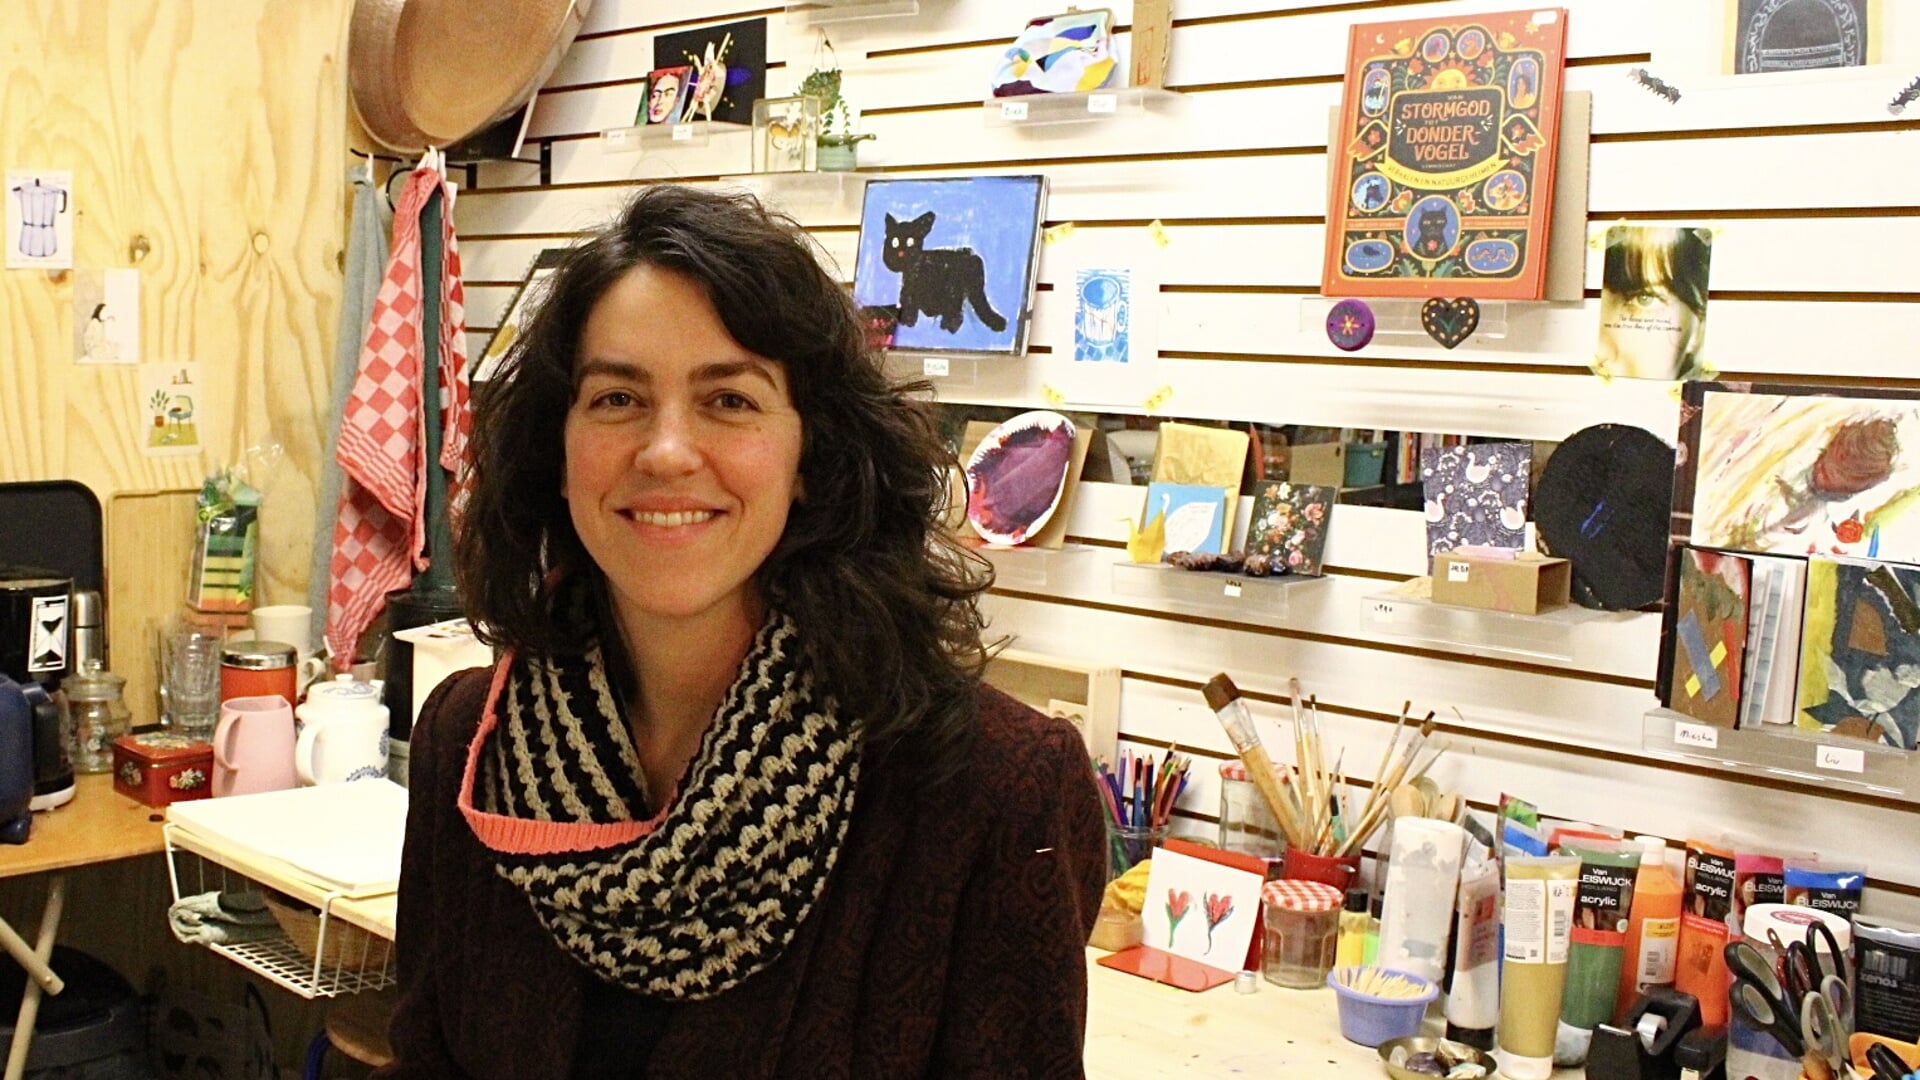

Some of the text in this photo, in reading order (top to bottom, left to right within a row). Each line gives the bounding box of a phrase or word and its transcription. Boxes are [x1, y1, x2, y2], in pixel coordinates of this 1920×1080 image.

[1401, 99, 1491, 121] STORMGOD
[1406, 125, 1481, 145] DONDER-
[1414, 143, 1470, 161] VOGEL
[1687, 857, 1736, 880] BLEISWIJC
[1710, 858, 1724, 867] Van
[1592, 868, 1608, 876] Van
[1578, 874, 1632, 887] EISWIJCK
[1767, 876, 1783, 885] Van
[1695, 881, 1728, 898] acrylic
[1745, 881, 1786, 894] BLEISW
[1580, 895, 1617, 907] acrylic
[1820, 891, 1837, 900] Van
[1796, 895, 1860, 910] BLEISWIJCK
